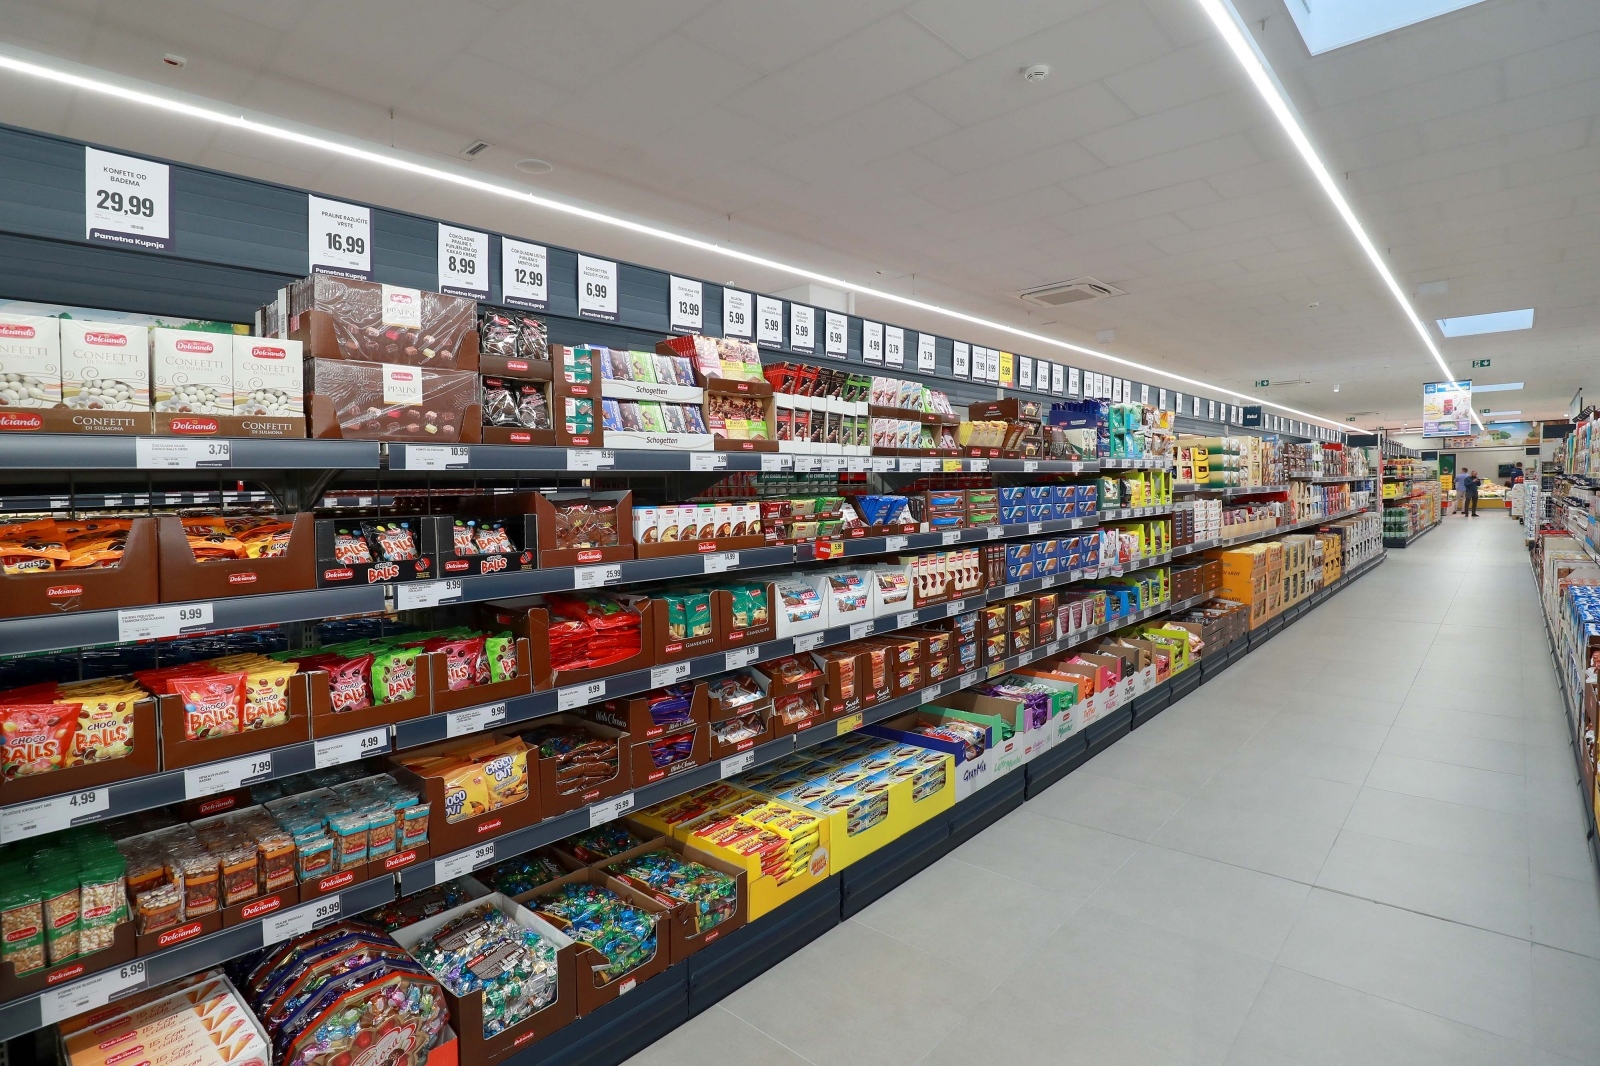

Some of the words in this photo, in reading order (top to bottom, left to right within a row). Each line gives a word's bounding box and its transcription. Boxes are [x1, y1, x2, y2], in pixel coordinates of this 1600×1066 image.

[103, 166, 135, 178] KONFETE
[136, 173, 147, 181] OD
[110, 175, 140, 187] BADEMA
[96, 189, 154, 218] 29,99
[321, 210, 343, 220] PRALINE
[337, 220, 354, 229] VRSTE
[94, 231, 134, 244] Pametna
[135, 238, 165, 250] Kupnja
[325, 232, 365, 255] 16,99
[448, 255, 475, 275] 8,99
[315, 267, 345, 277] Pametna
[345, 272, 367, 281] Kupnja
[515, 268, 543, 287] 12,99
[443, 288, 468, 297] Pametna
[468, 292, 486, 301] Kupnja
[586, 282, 607, 298] 6,99
[507, 298, 528, 307] Pametna
[528, 301, 545, 309] Kupnja
[678, 301, 699, 316] 13,99
[729, 311, 744, 325] 5,99
[764, 318, 779, 331] 5,99
[795, 324, 808, 336] 5,99
[86, 334, 127, 345] Dolciando
[829, 331, 842, 343] 6,99
[177, 342, 213, 352] Dolciando
[869, 340, 880, 351] 4,99
[889, 343, 899, 354] 3,79
[72, 349, 138, 363] CONFETTI
[253, 348, 286, 358] Dolciando
[165, 356, 223, 369] CONFETTI
[242, 361, 295, 374] CONFETTI
[635, 385, 668, 395] Schogetten
[72, 416, 135, 426] CONFETTI
[172, 421, 217, 431] Dolciando
[241, 421, 292, 431] CONFETTI
[646, 436, 678, 446] Schogetten
[208, 443, 229, 455] 3,79
[450, 446, 468, 457] 10,99
[382, 536, 416, 554] BALLS
[475, 532, 507, 551] BALLS
[335, 542, 368, 560] BALLS
[577, 552, 602, 561] Dolciando
[17, 559, 46, 570] CRISP
[374, 561, 393, 570] CHOCO
[446, 562, 470, 570] Dolciando
[480, 557, 508, 575] BALLS
[229, 574, 257, 583] Dolciando
[325, 571, 354, 579] Dolciando
[368, 564, 400, 584] BALLS
[606, 570, 621, 578] 25,99
[48, 587, 82, 596] Dolciando
[446, 580, 461, 590] 9,99
[800, 590, 816, 599] RICE
[179, 608, 202, 621] 9,99
[390, 669, 412, 682] CHOCO
[675, 665, 686, 673] 9,99
[340, 682, 360, 692] CHOCO
[588, 685, 600, 694] 9,99
[876, 686, 890, 698] Snack
[255, 694, 278, 704] CHOCO
[845, 698, 860, 709] Snack
[200, 701, 226, 711] CHOCO
[244, 698, 287, 723] BALLS
[491, 705, 505, 717] 9,99
[189, 705, 236, 730] BALLS
[87, 720, 117, 731] CHOCO
[12, 735, 46, 746] CHOCO
[75, 725, 127, 754] BALLS
[361, 736, 378, 748] 4,99
[0, 741, 58, 764] BALLS
[251, 760, 271, 774] 7,99
[485, 754, 514, 774] CHOCO
[69, 791, 96, 807] 4,99
[615, 800, 629, 810] 35,99
[201, 799, 234, 813] Dolciando
[475, 845, 494, 859] 39,99
[386, 852, 416, 868] Dolciando
[320, 872, 353, 889] Dolciando
[243, 898, 280, 916] Dolciando
[315, 901, 340, 917] 39,99
[160, 925, 201, 944] Dolciando
[48, 966, 83, 982] Dolciando
[120, 962, 145, 979] 6,99
[100, 1031, 137, 1049] Dolciando
[163, 1026, 187, 1041] Coni
[171, 1041, 195, 1055] Coni
[106, 1046, 144, 1065] Dolciando
